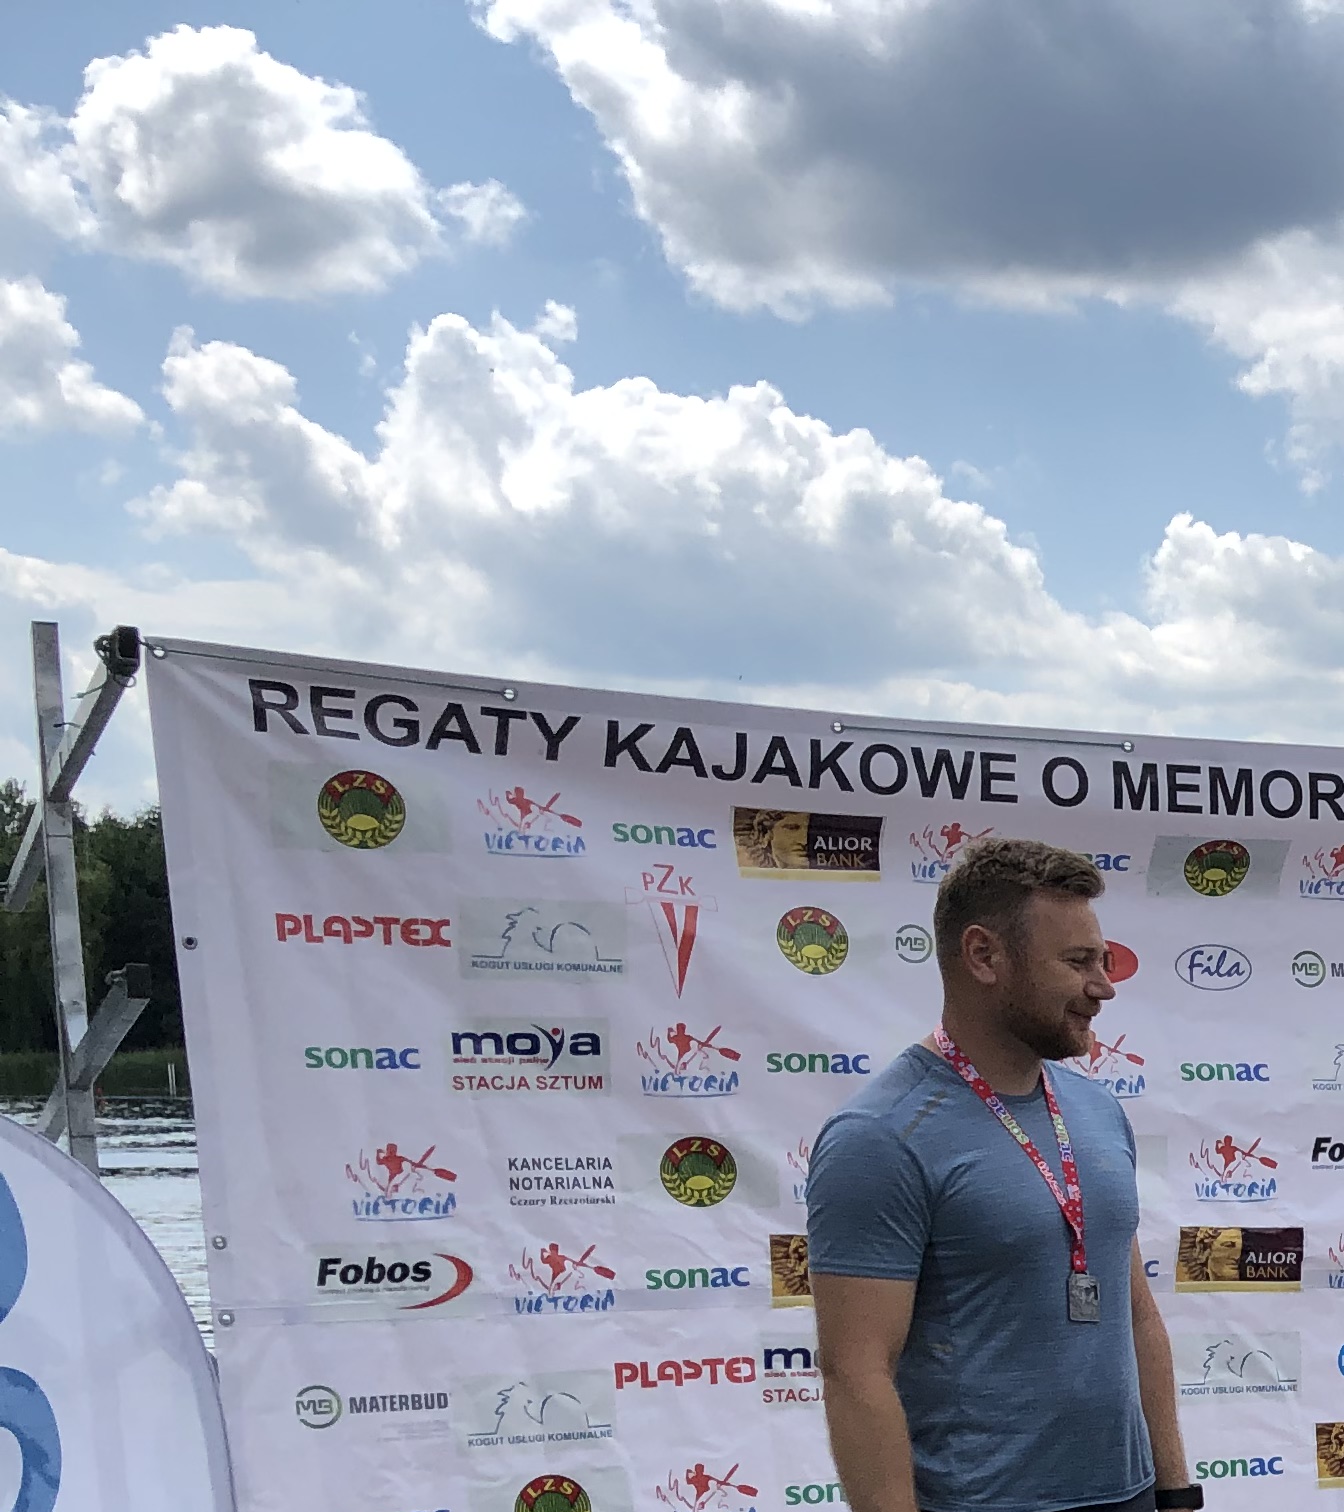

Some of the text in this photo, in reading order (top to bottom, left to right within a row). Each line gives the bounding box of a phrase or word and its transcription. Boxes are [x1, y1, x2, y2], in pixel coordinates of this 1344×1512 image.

[249, 678, 580, 761] REGATY
[604, 719, 1019, 803] KAJAKOWE
[1042, 756, 1089, 807] O
[331, 773, 389, 796] LZS
[612, 822, 717, 849] sonac
[813, 835, 873, 851] ALIOR
[816, 852, 865, 867] BANK
[641, 863, 697, 896] PZK
[786, 910, 832, 926] LZS
[472, 960, 510, 971] KOGUT
[556, 961, 623, 974] KOMUNALNE
[1188, 950, 1245, 982] Fila
[451, 1023, 601, 1071] moya
[304, 1046, 421, 1070] sonac
[766, 1051, 871, 1075] sonac
[1180, 1062, 1270, 1082] sonac
[452, 1075, 603, 1091] STACJA SZTUM
[1313, 1083, 1342, 1091] KOGUT
[674, 1140, 721, 1159] LZS
[508, 1157, 613, 1172] KANCELARIA
[509, 1176, 615, 1191] NOTARIALNA
[1245, 1251, 1297, 1265] ALIOR
[317, 1256, 432, 1287] Fobos
[646, 1266, 750, 1290] sonac
[1246, 1266, 1289, 1278] BANK
[762, 1388, 820, 1404] STACJ
[1182, 1387, 1210, 1396] KOGUT
[1246, 1384, 1297, 1394] KOMUNALNE
[467, 1437, 505, 1448] KOGUT
[548, 1429, 612, 1442] KOMUNALNE
[1196, 1457, 1283, 1479] sonac
[526, 1479, 574, 1498] LZS
